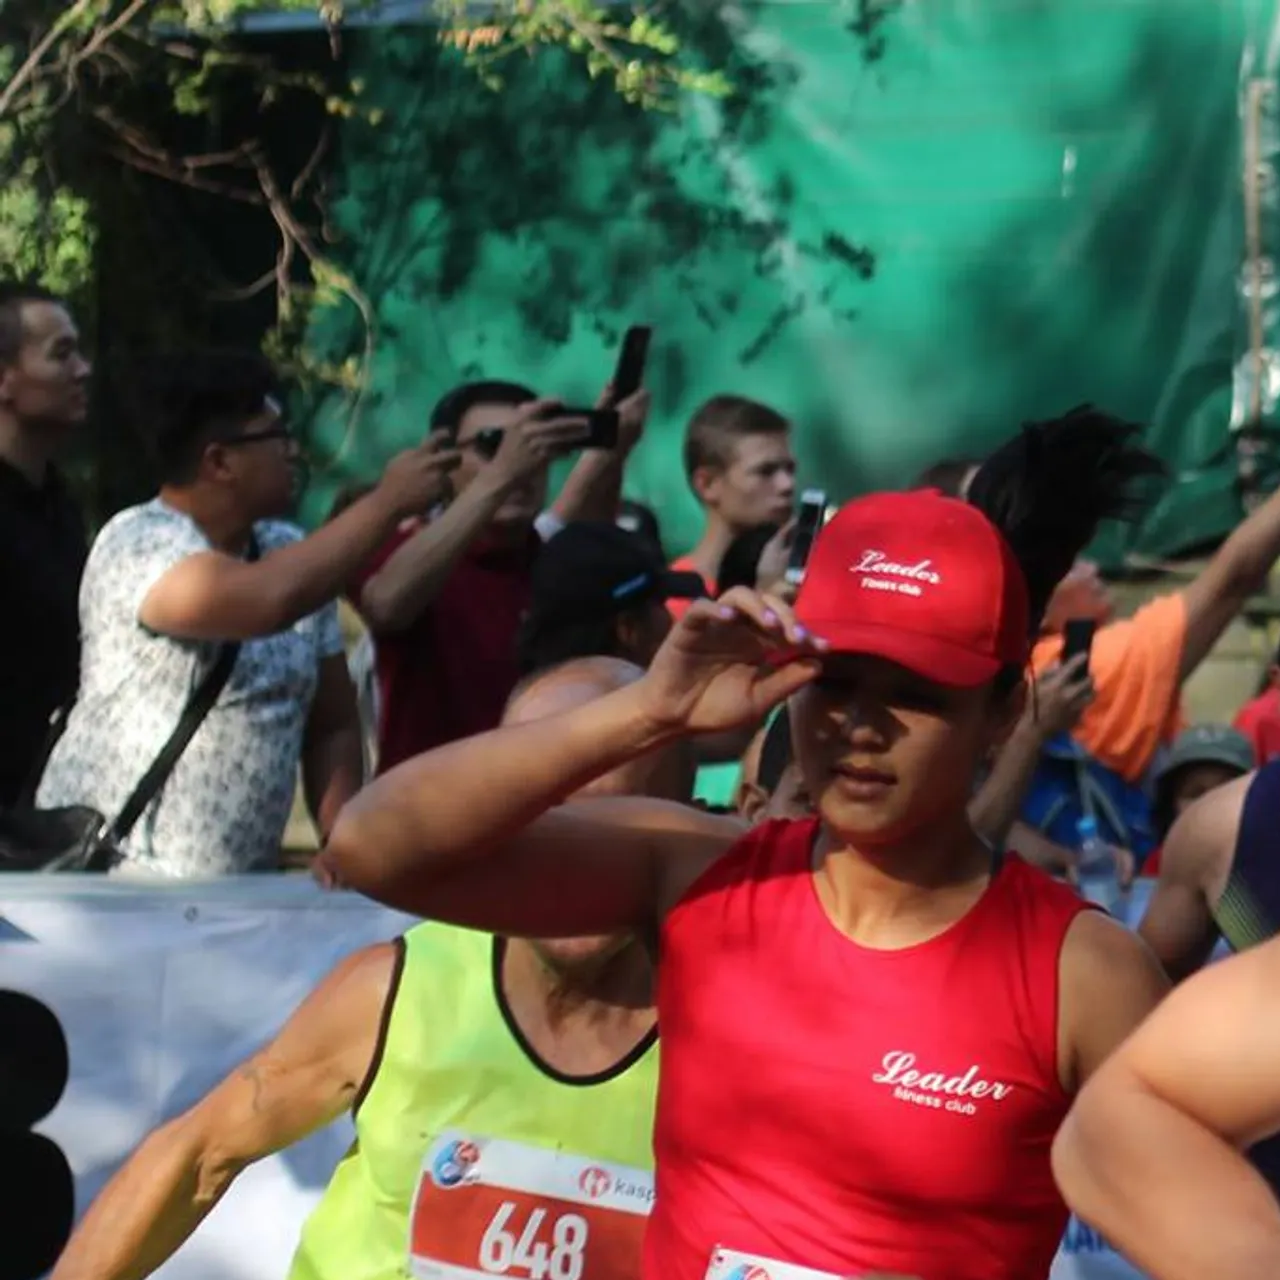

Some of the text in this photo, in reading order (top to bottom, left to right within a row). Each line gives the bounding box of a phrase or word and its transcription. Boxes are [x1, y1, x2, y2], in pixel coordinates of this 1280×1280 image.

[849, 550, 940, 584] Leader
[872, 1050, 1014, 1101] Leader
[945, 1099, 976, 1115] club
[613, 1178, 656, 1202] kasp
